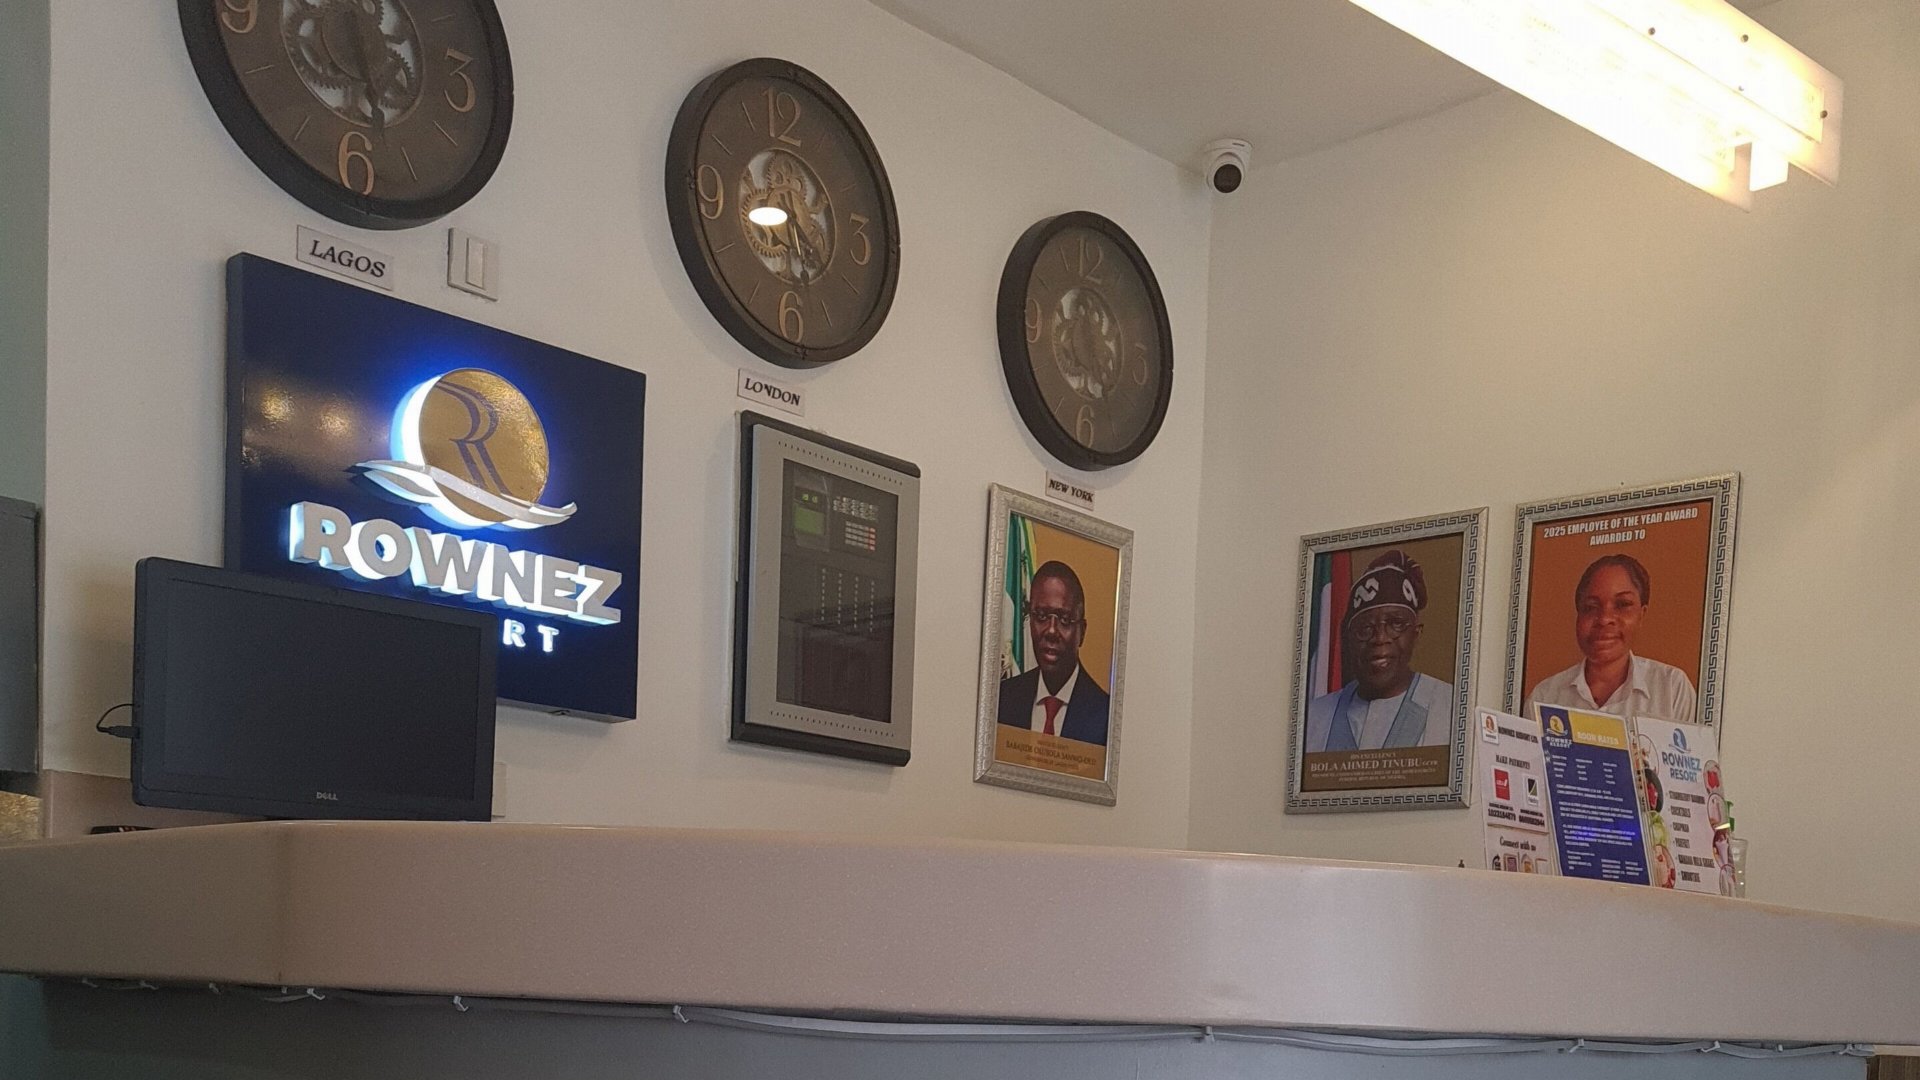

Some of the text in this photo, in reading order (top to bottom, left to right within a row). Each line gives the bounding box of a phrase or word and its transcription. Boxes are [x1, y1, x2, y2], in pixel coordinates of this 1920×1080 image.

[444, 48, 476, 113] 3
[762, 86, 801, 147] 12
[338, 131, 375, 196] 6
[698, 165, 724, 220] 9
[309, 240, 386, 278] LAGOS
[850, 213, 871, 266] 3
[1077, 237, 1104, 285] 12
[779, 291, 804, 343] 6
[1024, 298, 1043, 343] 9
[744, 378, 801, 406] LONDON
[1075, 404, 1095, 449] 6
[1048, 479, 1095, 502] NEW YORK
[1544, 508, 1699, 538] 2025 EMPLOYEE OF THE YEAR AWARD
[1590, 529, 1646, 546] AWARDED TO
[290, 501, 623, 625] ROWNEZ
[1311, 762, 1339, 772] BOLA
[1341, 760, 1380, 771] AHMED
[1381, 758, 1422, 769] TINUBU
[1661, 751, 1702, 771] ROWNEZ
[1670, 768, 1698, 783] RESORT
[316, 791, 338, 801] DELL
